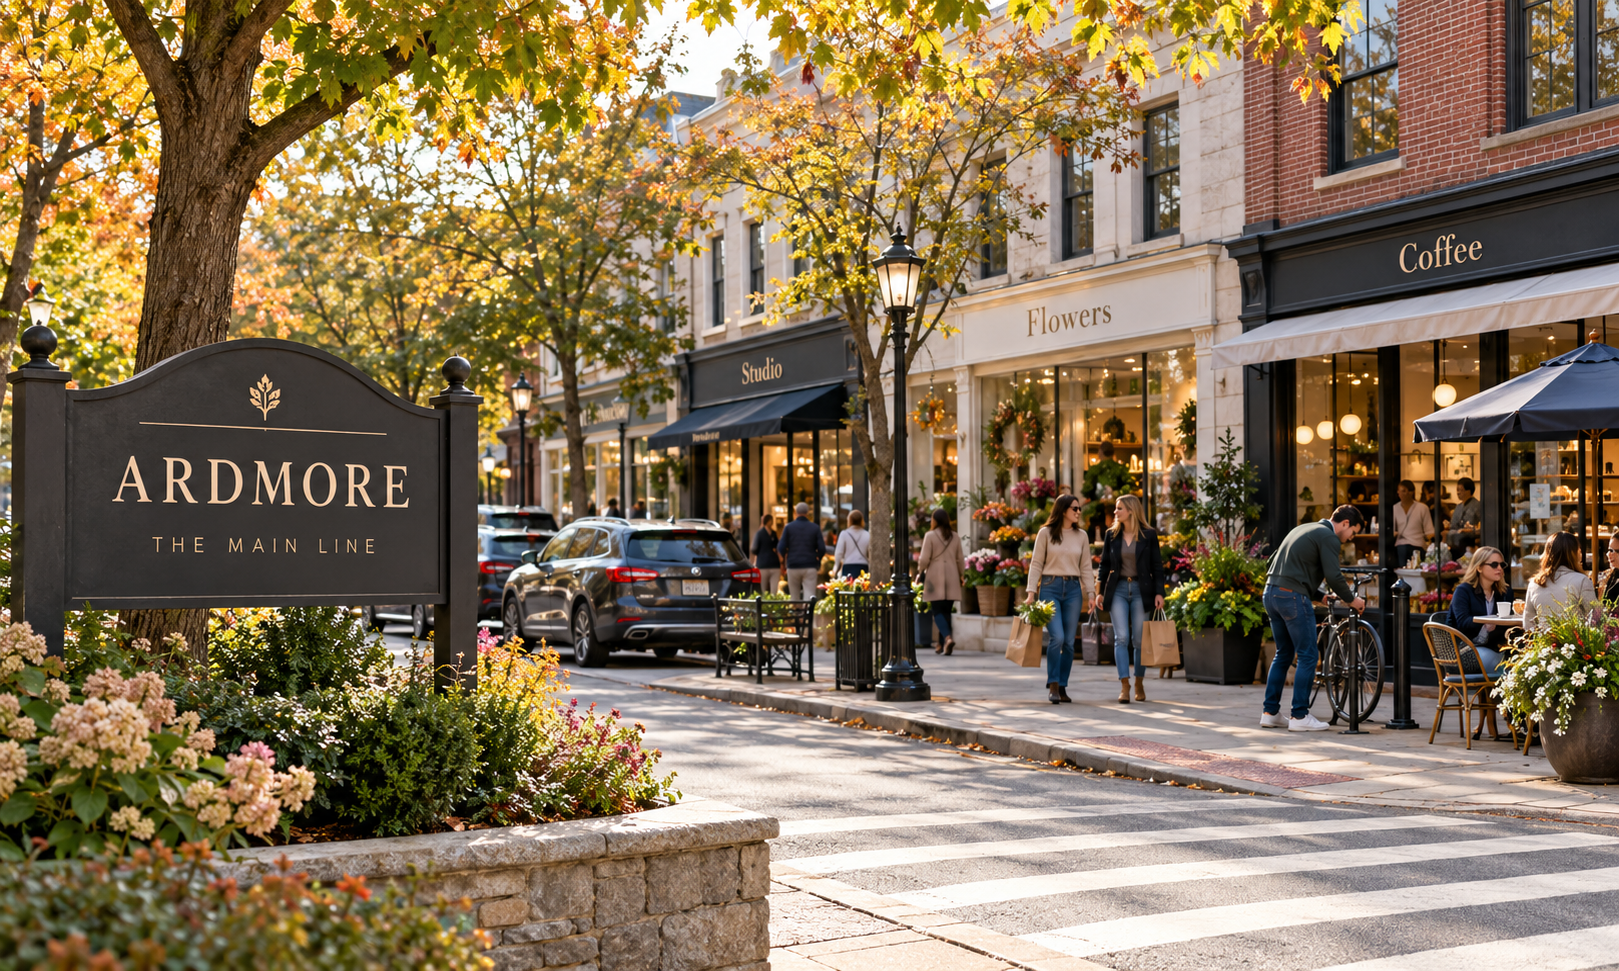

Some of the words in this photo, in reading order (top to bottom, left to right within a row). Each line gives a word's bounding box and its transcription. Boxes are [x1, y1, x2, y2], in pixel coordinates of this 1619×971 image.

[1398, 233, 1483, 274] Coffee
[1027, 304, 1112, 337] Flowers
[741, 356, 783, 386] Studio
[111, 455, 410, 509] ARDMORE
[152, 536, 205, 554] THE
[228, 537, 298, 554] MAIN
[318, 538, 376, 555] LINE
